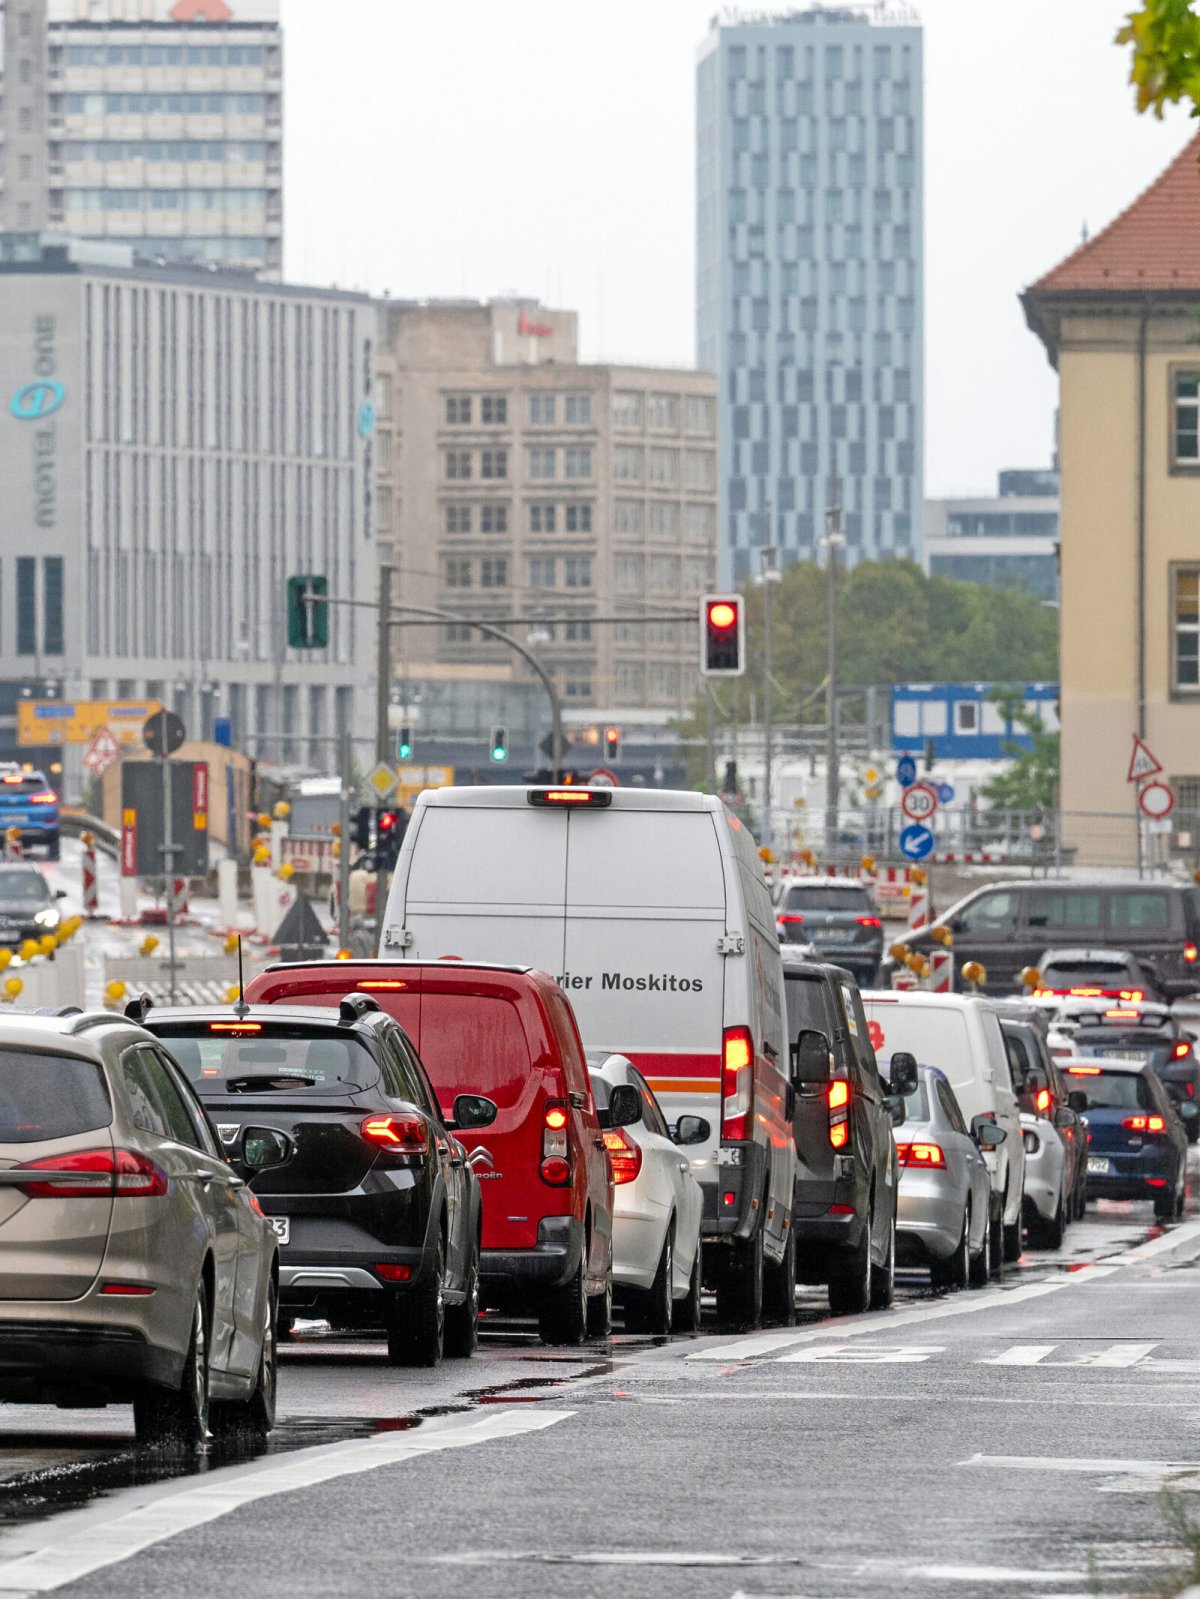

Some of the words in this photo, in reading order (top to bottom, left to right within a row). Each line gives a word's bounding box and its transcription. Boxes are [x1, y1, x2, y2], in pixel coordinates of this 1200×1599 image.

[910, 796, 930, 811] 30
[552, 972, 593, 989] rier
[602, 973, 703, 992] Moskitos
